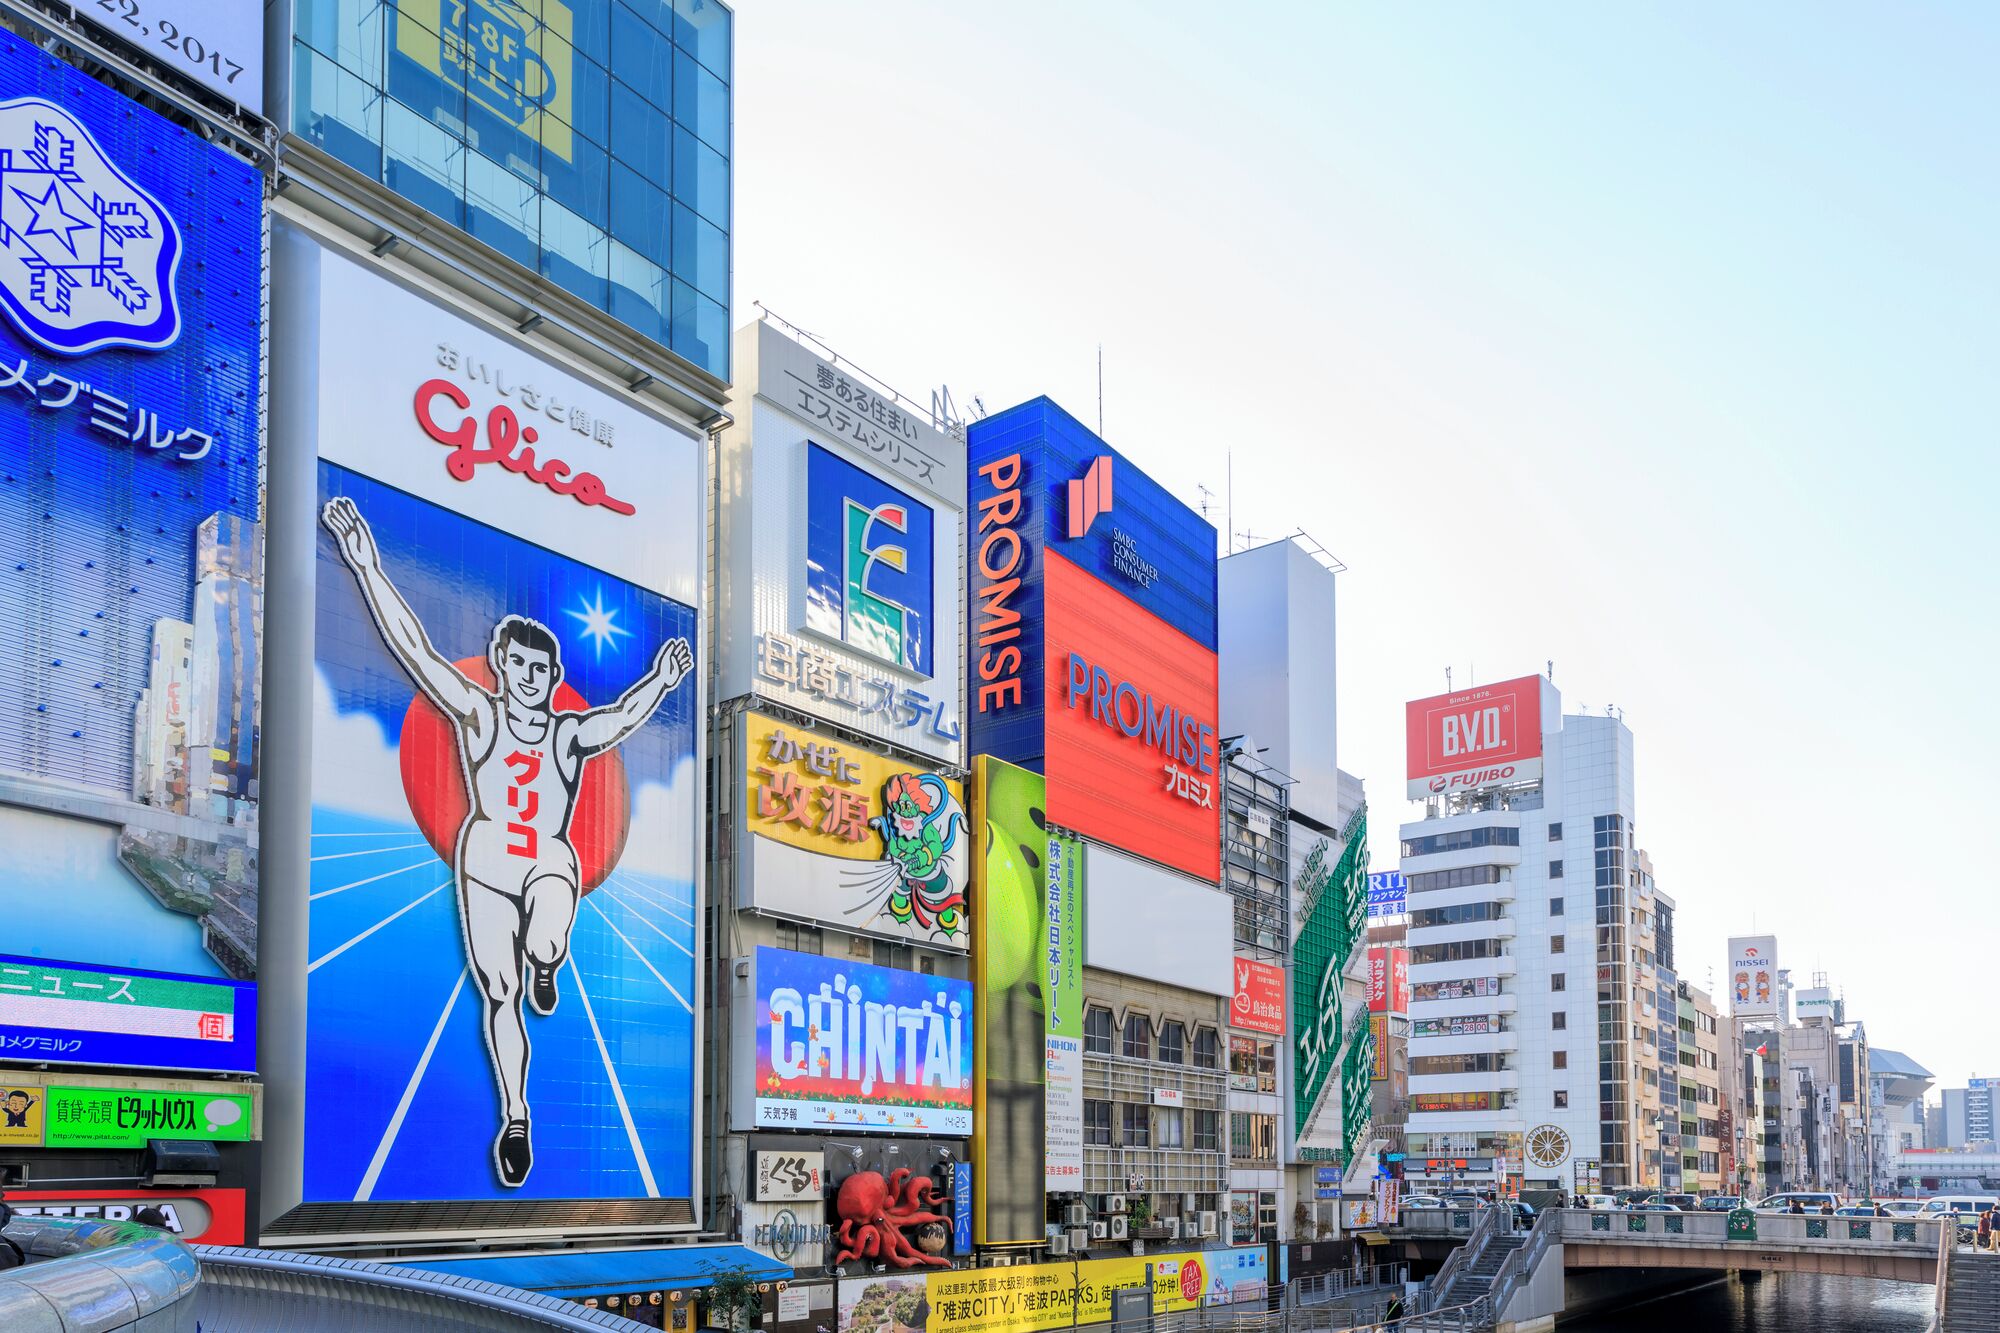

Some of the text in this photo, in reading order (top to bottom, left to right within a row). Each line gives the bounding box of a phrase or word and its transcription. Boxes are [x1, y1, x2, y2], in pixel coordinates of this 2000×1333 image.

[97, 0, 245, 84] 2, 2017
[0, 358, 213, 460] メグミルク
[437, 342, 615, 449] おいしさと健康
[816, 363, 918, 441] 夢ある住まい
[414, 378, 636, 517] Glico
[797, 388, 934, 485] エステムシリーズ
[1113, 527, 1137, 553] SMBC
[1113, 541, 1159, 583] CONSUMER
[979, 453, 1022, 713] PROMISE
[1113, 555, 1150, 590] FINANCE
[1069, 651, 1214, 776] PROMISE
[1450, 694, 1470, 703] Since
[1442, 706, 1507, 758] B.V.D.
[767, 729, 862, 786] かぜに
[1450, 766, 1515, 788] FUJIBO
[503, 749, 544, 860] グリコ
[756, 766, 872, 843] 改源
[1164, 763, 1214, 810] プロミス
[1374, 958, 1385, 1000] カラオケ
[769, 973, 963, 1093] CHINTAI
[1047, 1039, 1077, 1052] NIHON
[56, 1098, 113, 1125] 賃貸・売買
[117, 1095, 197, 1131] ピタットハウス
[763, 1106, 798, 1121] 天気予報
[1182, 1278, 1201, 1298] FREE
[1183, 1263, 1199, 1282] TAX
